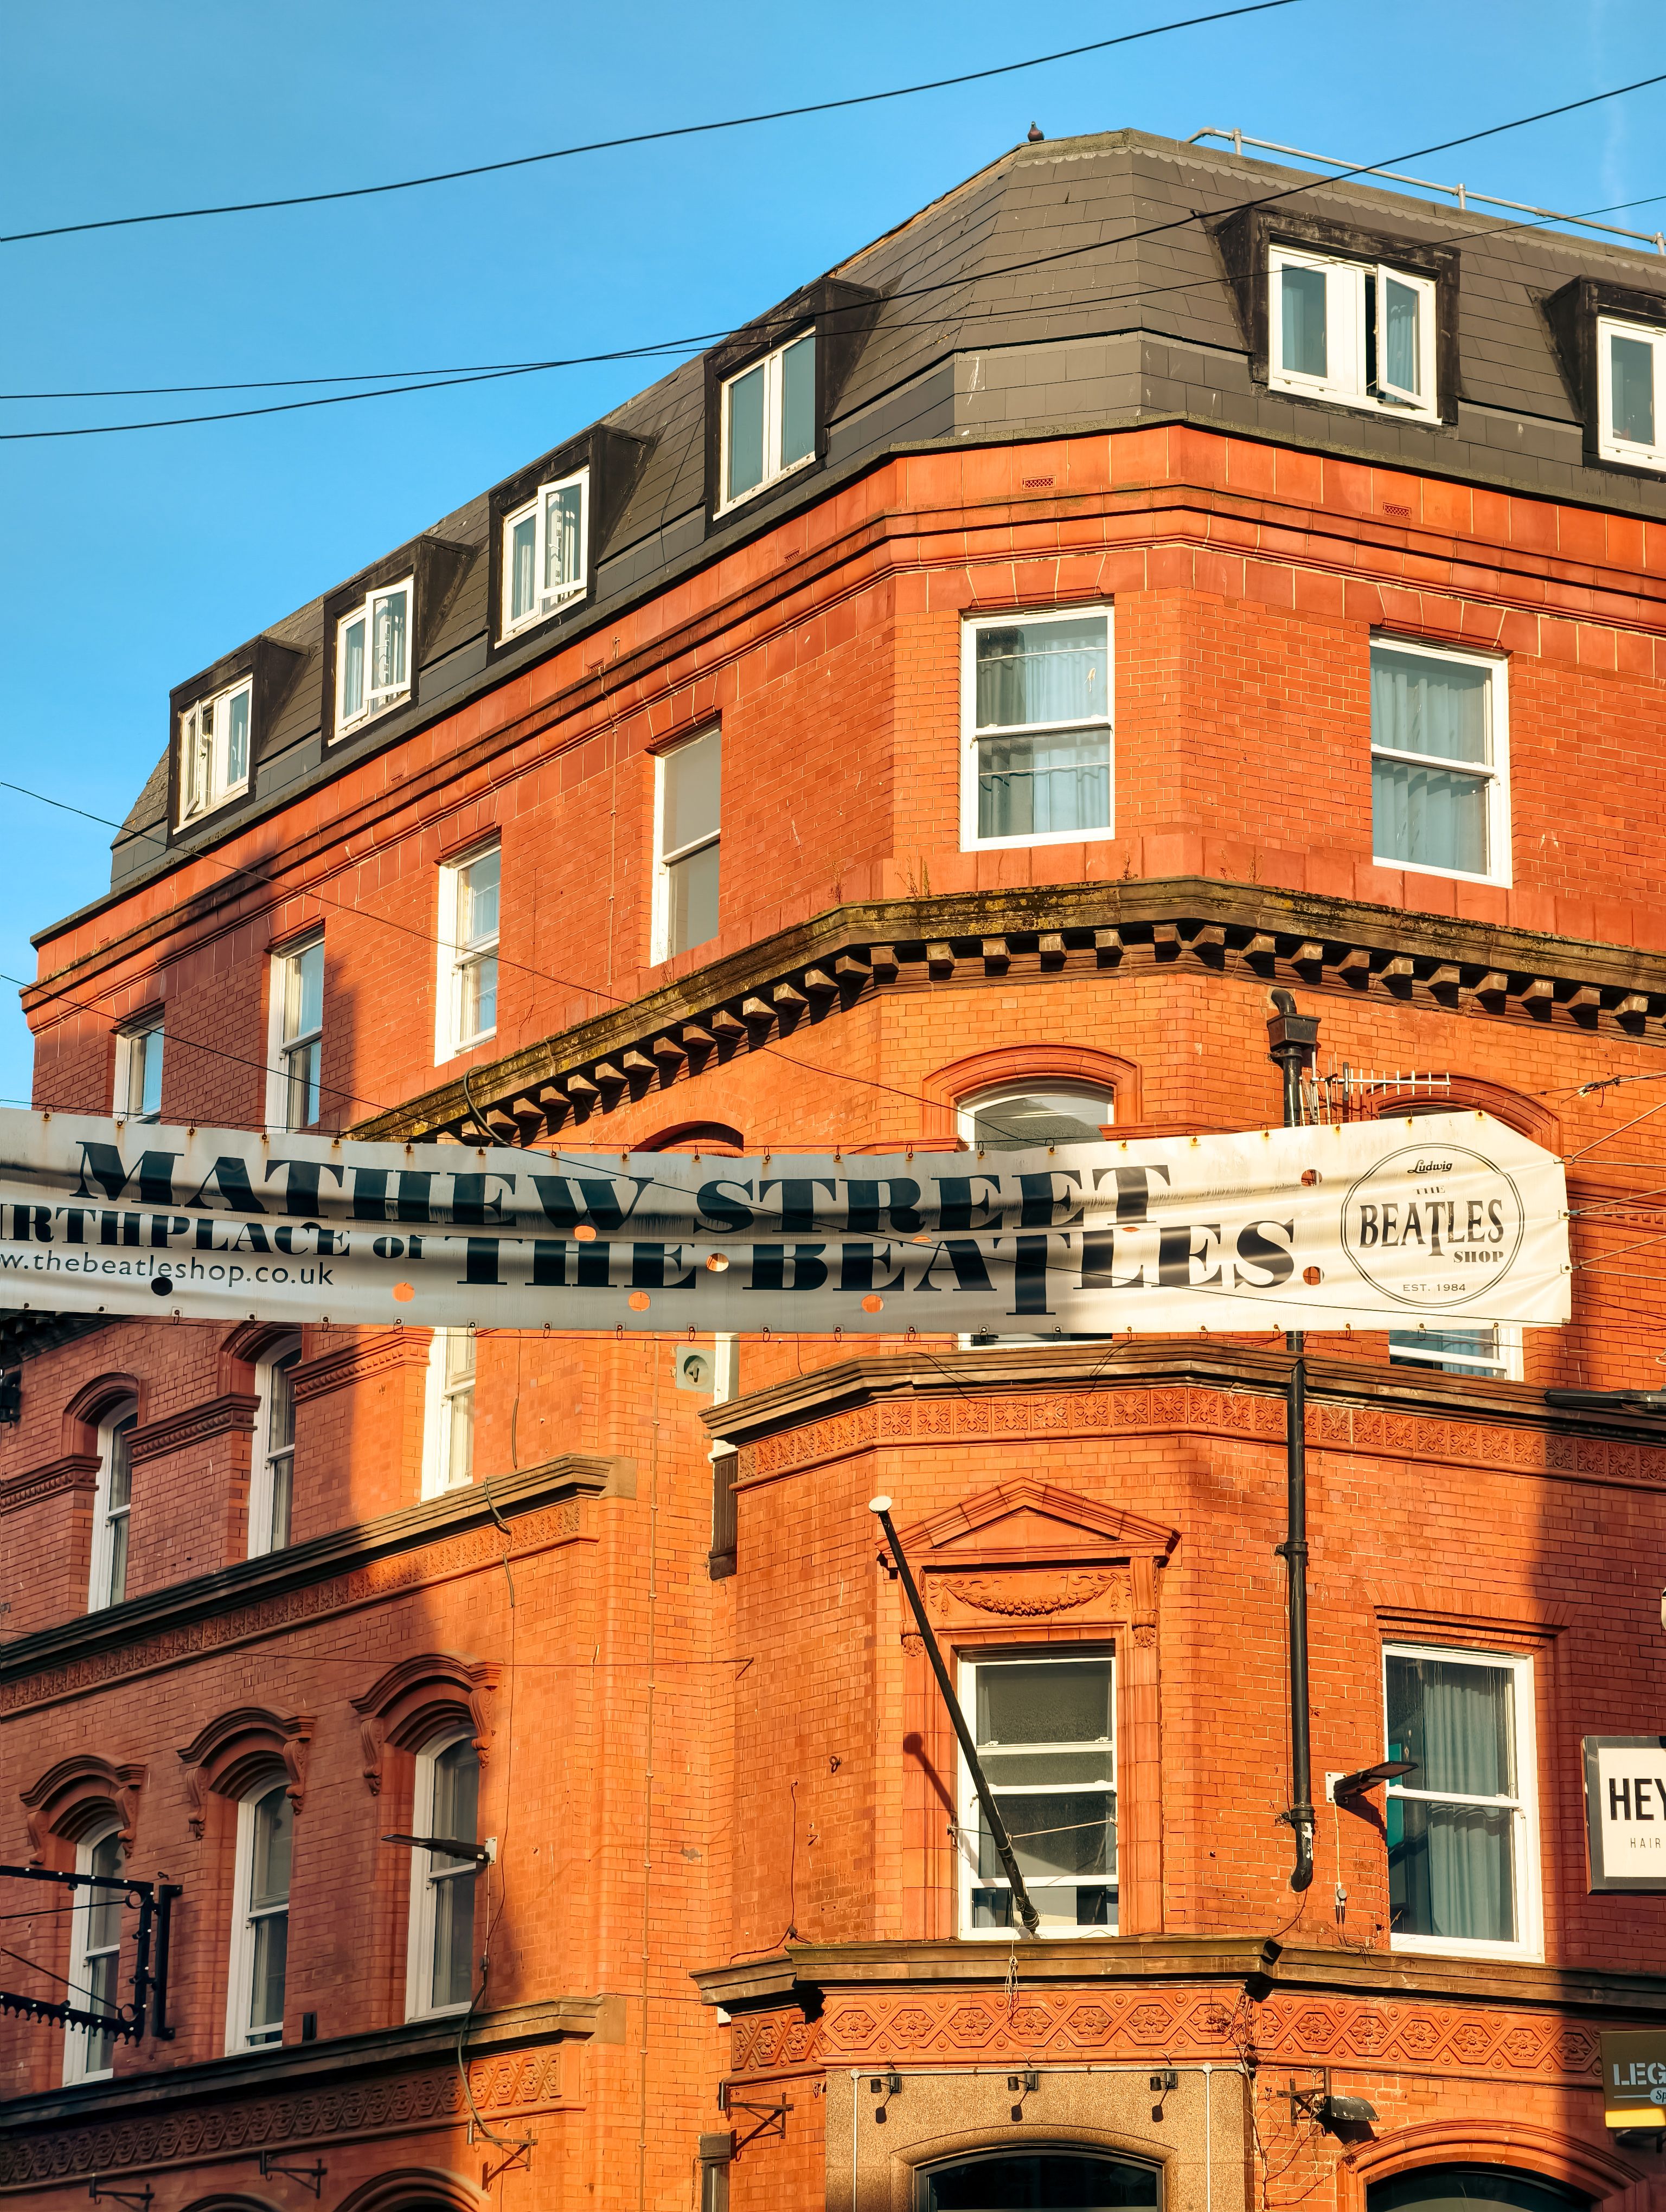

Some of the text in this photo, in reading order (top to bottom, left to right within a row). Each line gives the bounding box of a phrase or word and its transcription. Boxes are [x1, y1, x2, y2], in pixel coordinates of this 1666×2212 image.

[1407, 1160, 1453, 1174] Ludwig
[69, 1141, 1171, 1234] MATHEW STREET
[1413, 1186, 1445, 1195] THE
[0, 1204, 426, 1259] RTHPLACE of
[1359, 1199, 1504, 1257] BEATLES
[0, 1250, 334, 1287] w.thebeatleshop.co.uk
[445, 1218, 1295, 1316] THE BEATLES
[1453, 1251, 1504, 1263] SHOP
[1437, 1283, 1466, 1291] 1984
[1630, 1838, 1661, 1848] HAIR
[1613, 2062, 1666, 2085] LEG
